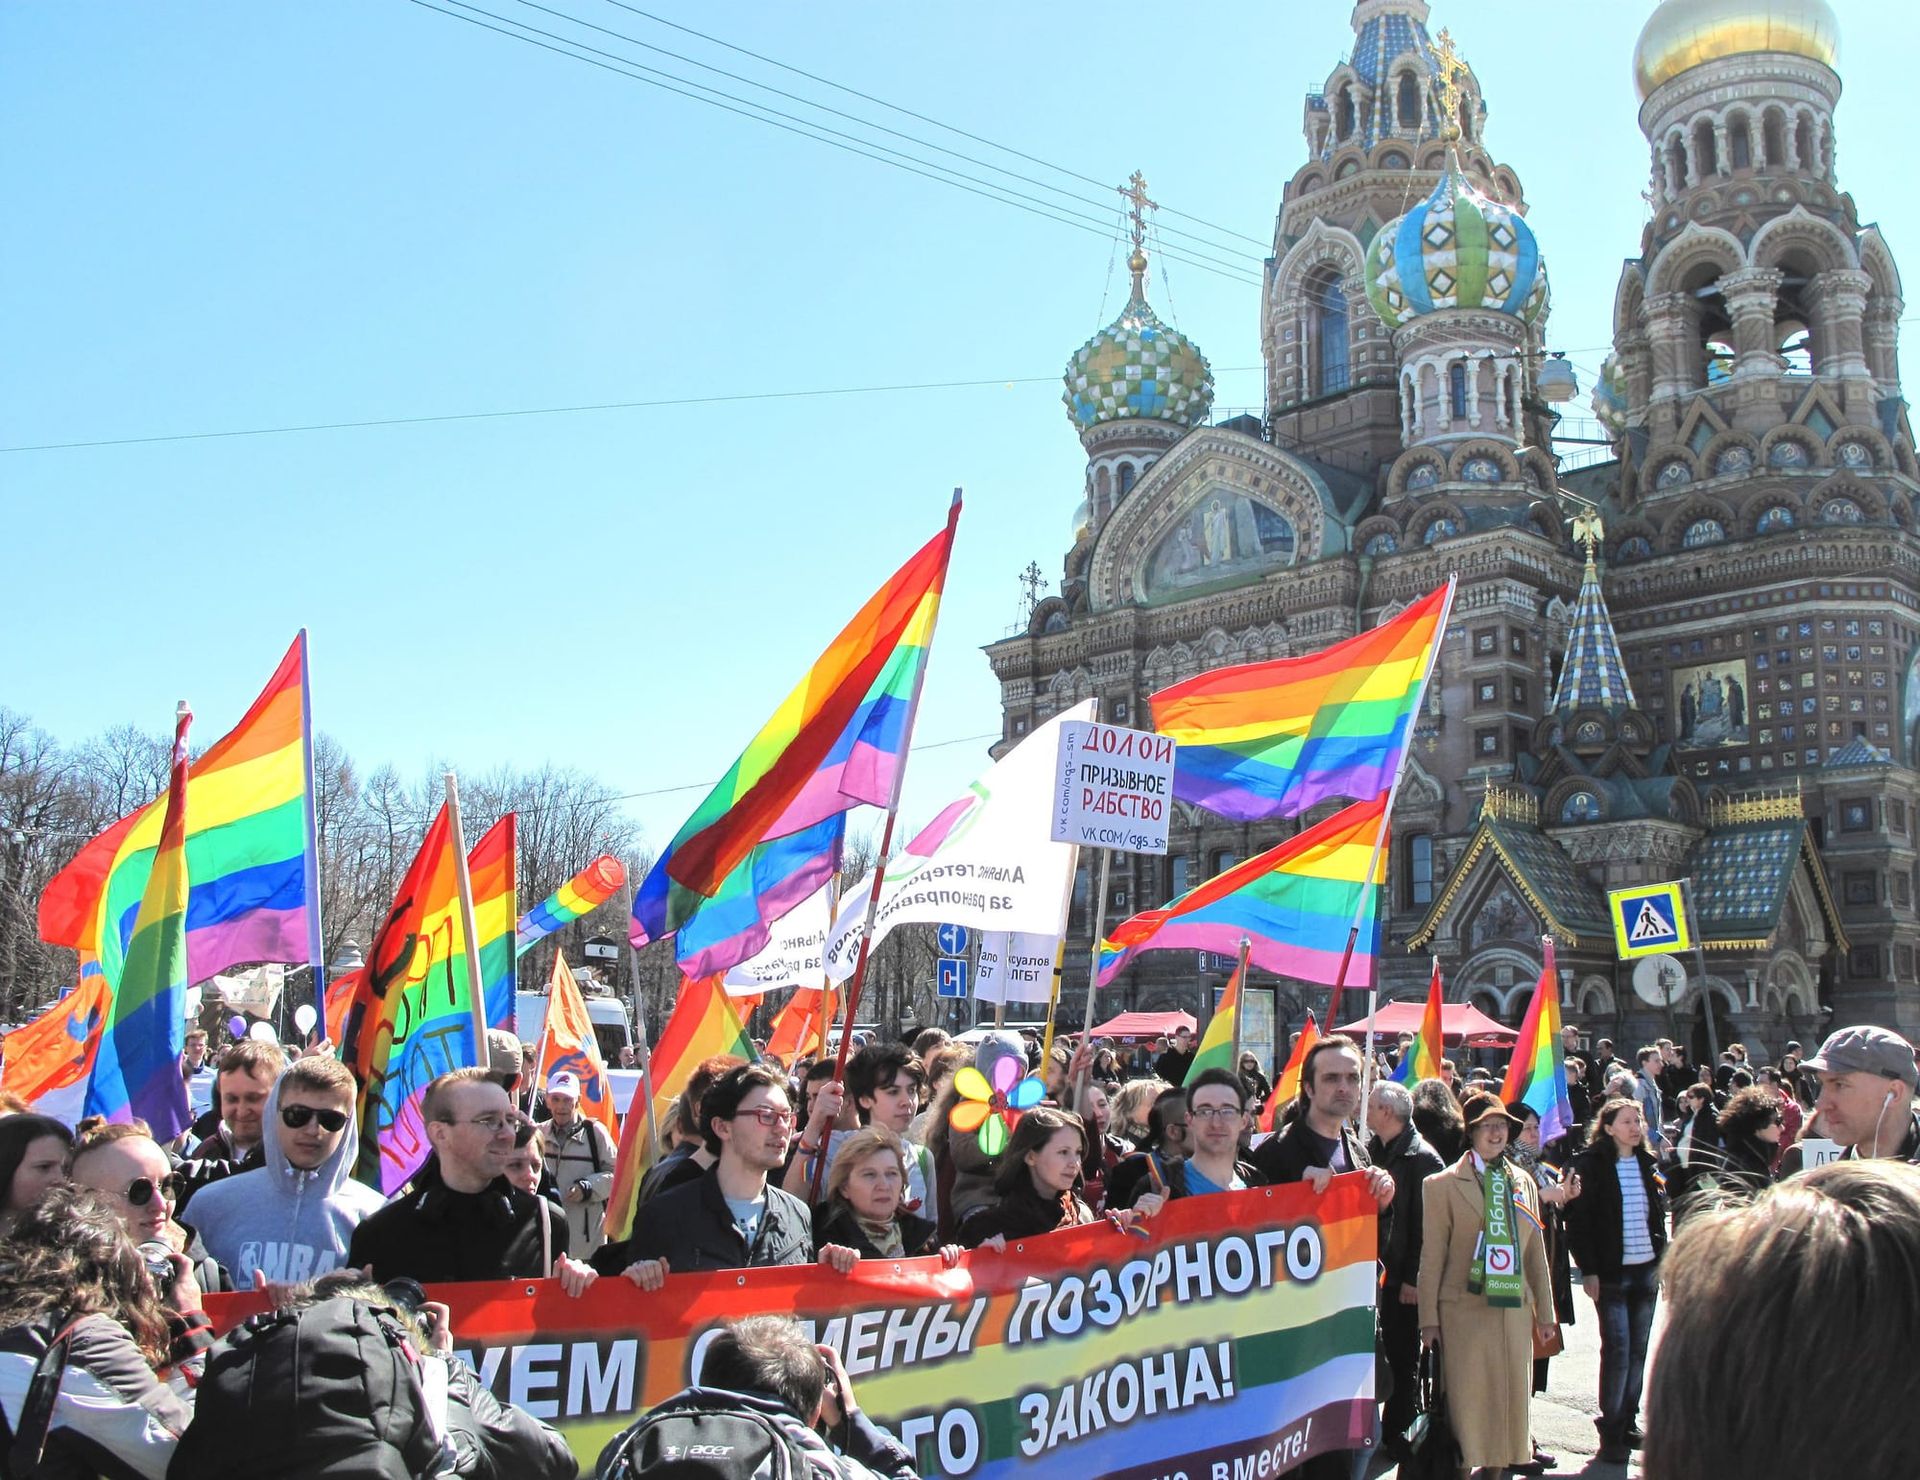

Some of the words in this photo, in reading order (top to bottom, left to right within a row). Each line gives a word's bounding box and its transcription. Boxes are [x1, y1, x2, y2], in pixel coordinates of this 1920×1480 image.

[1082, 726, 1172, 763] ДОЛОЙ
[1080, 764, 1167, 795] ПРИЗЫВНОЕ
[1083, 788, 1163, 821] РАБСТВО
[1490, 1169, 1507, 1237] Яблок
[1008, 1225, 1321, 1343] ПОЗОРНОГО
[1488, 1280, 1520, 1290] Яблоко
[1019, 1341, 1234, 1456] ЗАКОНА!
[690, 1444, 734, 1455] acer
